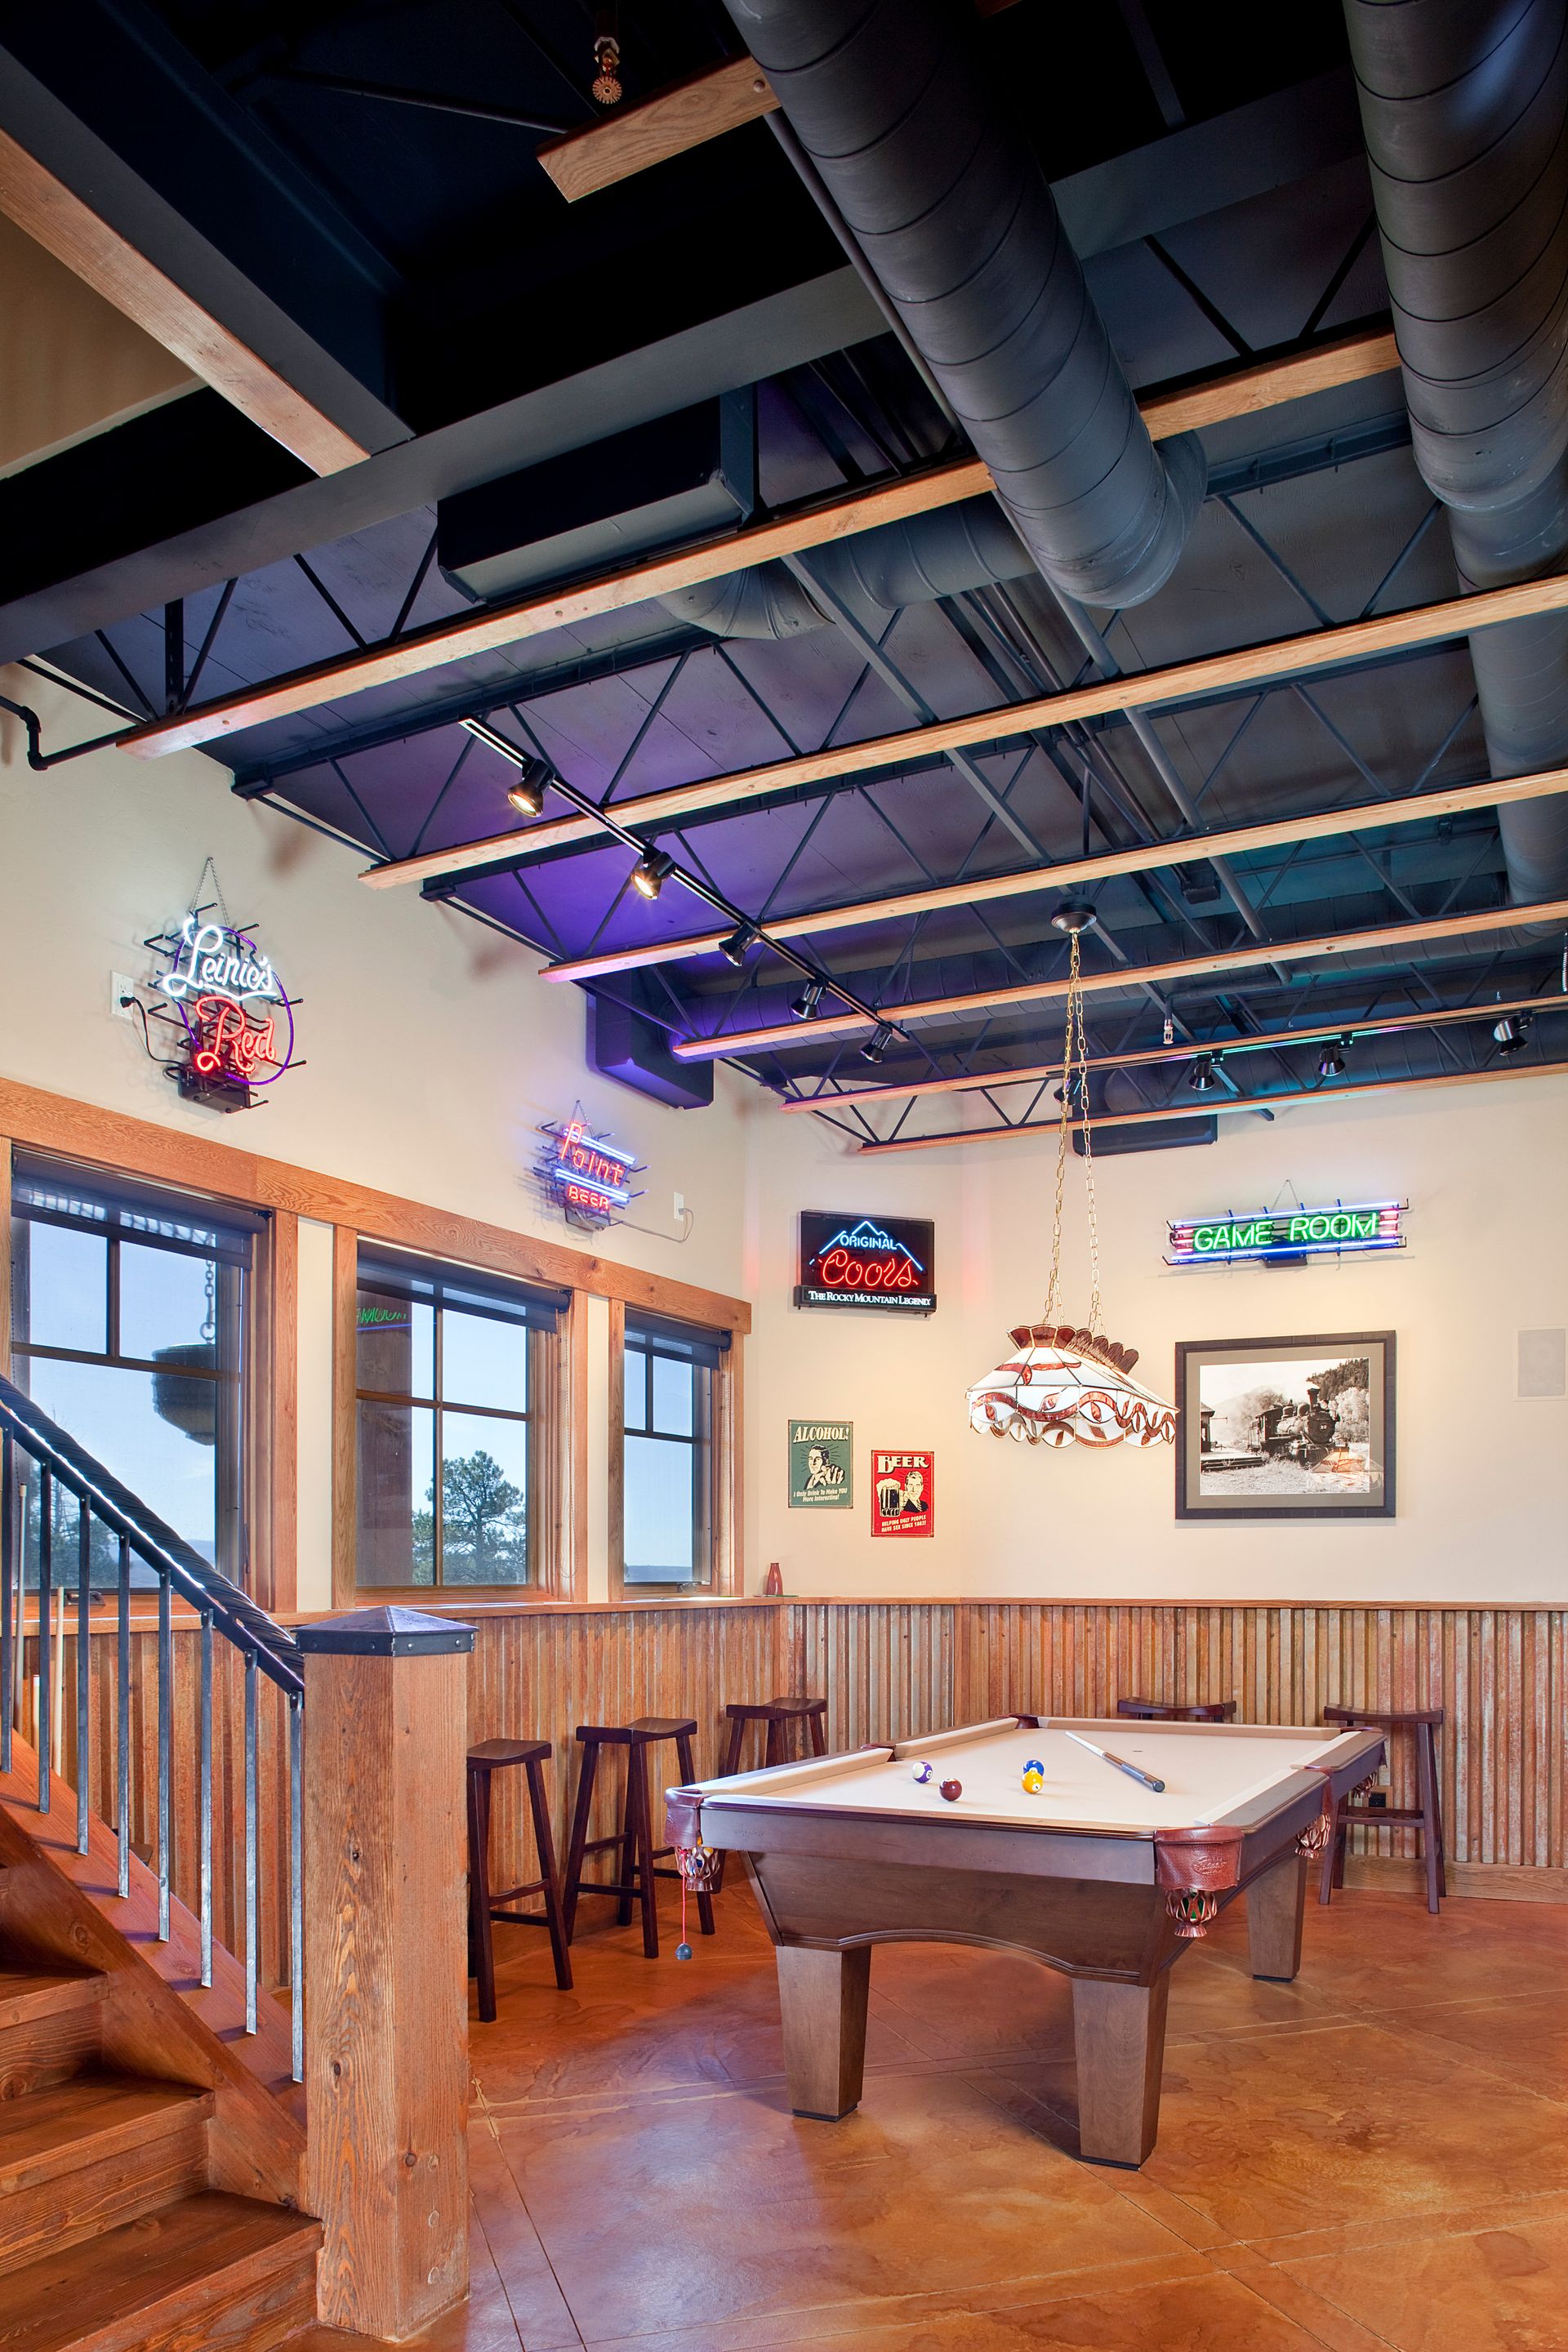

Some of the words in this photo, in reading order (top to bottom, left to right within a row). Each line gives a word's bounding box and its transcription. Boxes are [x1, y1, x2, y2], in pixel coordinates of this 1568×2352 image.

[195, 996, 276, 1072] Red
[560, 1121, 625, 1186] Point
[568, 1184, 609, 1209] BEER
[840, 1234, 898, 1250] ORIGINAL
[1194, 1220, 1273, 1251] GAME
[1290, 1212, 1378, 1241] ROOM
[822, 1250, 915, 1287] Coors
[808, 1290, 826, 1301] THE
[826, 1291, 854, 1303] ROCKY
[854, 1294, 898, 1304] MOUNTAIN
[792, 1426, 849, 1444] ALCOHOL!
[876, 1455, 929, 1473] BEER
